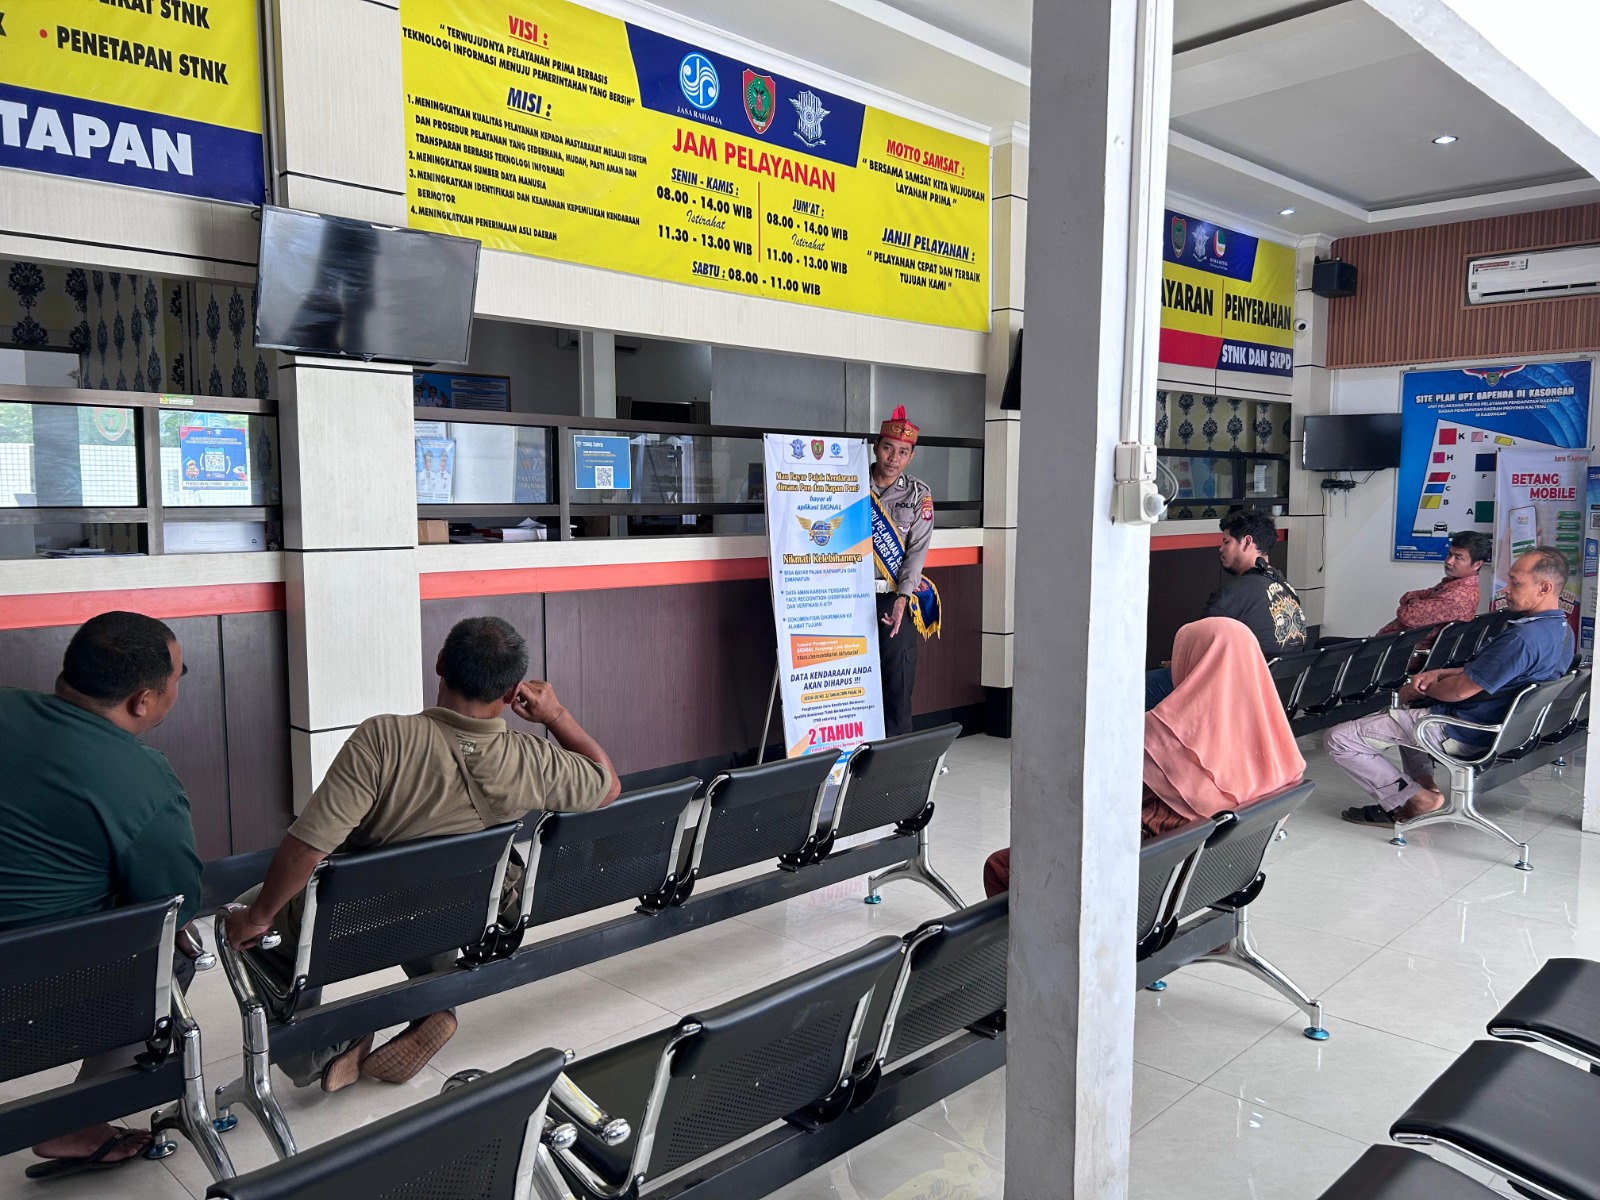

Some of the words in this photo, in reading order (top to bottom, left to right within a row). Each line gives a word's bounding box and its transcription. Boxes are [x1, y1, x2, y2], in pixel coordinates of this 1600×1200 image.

[160, 0, 210, 29] STNK
[509, 15, 538, 42] VISI
[57, 25, 172, 73] PENETAPAN
[179, 53, 228, 85] STNK
[402, 27, 451, 51] TEKNOLOGI
[453, 43, 497, 66] INFORMASI
[499, 58, 530, 76] MENUJU
[533, 68, 587, 93] PEMERINTAHAN
[589, 84, 607, 99] YANG
[447, 26, 504, 53] TERWUJUDNYA
[507, 45, 550, 67] PELAYANAN
[552, 59, 575, 75] PRIMA
[577, 67, 608, 85] BERBASIS
[507, 87, 542, 114] MISI
[677, 106, 693, 117] JASA
[693, 111, 722, 125] RAHARJA
[0, 101, 193, 176] TAPAN
[415, 96, 470, 119] MENINGKATKAN
[472, 111, 502, 128] KUALITAS
[504, 120, 539, 138] PELAYANAN
[540, 130, 564, 145] KEPADA
[565, 137, 602, 154] MASYARAKAT
[603, 147, 627, 160] MELALUI
[628, 153, 648, 165] SISTEM
[415, 114, 431, 127] DAN
[433, 118, 469, 136] PROSEDUR
[470, 127, 508, 146] PELAYANAN
[508, 138, 526, 151] YANG
[527, 144, 564, 162] SEDERHANA,
[565, 153, 588, 168] MUDAH,
[590, 160, 605, 170] PASTI
[606, 163, 624, 176] AMAN
[625, 168, 637, 179] DAN
[416, 133, 462, 153] TRANSPARAN
[463, 144, 493, 160] BERBASIS
[495, 152, 530, 170] TEKNOLOGI
[532, 161, 565, 178] INFORMASI
[672, 128, 717, 161] JAM
[724, 141, 835, 193] PELAYANAN
[886, 139, 921, 163] MOTTO
[923, 151, 960, 175] SAMSAT
[416, 152, 472, 173] MENINGKATKAN
[474, 163, 499, 179] SUMBER
[501, 172, 517, 184] DAYA
[518, 175, 546, 190] MANUSIA
[671, 168, 698, 186] SENIN
[706, 177, 734, 195] KAMIS
[869, 160, 904, 179] BERSAMA
[905, 170, 931, 187] SAMSAT
[933, 178, 948, 192] KITA
[950, 183, 985, 202] WUJUDKAN
[417, 170, 473, 190] MENINGKATKAN
[475, 182, 515, 199] IDENTIFIKASI
[517, 192, 530, 203] DAN
[532, 194, 565, 211] KEAMANAN
[567, 203, 605, 219] KEPEMILIKAN
[606, 211, 640, 226] KENDARAAN
[418, 188, 456, 204] BERMOTOR
[656, 186, 688, 204] 08.00
[701, 196, 730, 214] 14.00
[733, 204, 753, 219] WIB
[896, 182, 928, 201] LAYANAN
[930, 193, 951, 207] PRIMA
[418, 206, 474, 225] MENINGKATKAN
[476, 216, 517, 233] PENERIMAAN
[518, 225, 532, 236] ASLI
[534, 228, 557, 241] DAERAH
[686, 210, 726, 230] Istirahat
[766, 212, 794, 229] 08.00
[804, 221, 829, 237] 14.00
[831, 227, 848, 241] WIB
[658, 225, 688, 243] 11.30
[701, 234, 730, 252] 13.00
[733, 241, 753, 256] WIB
[791, 234, 825, 252] Istirahat
[882, 228, 911, 246] JANJI
[914, 235, 970, 260] PELAYANAN
[767, 248, 793, 264] 11.00
[803, 255, 829, 271] 13.00
[831, 261, 848, 275] WIB
[874, 252, 916, 270] PELAYANAN
[917, 261, 937, 274] CEPAT
[939, 265, 953, 278] DAN
[955, 269, 981, 283] TERBAIK
[692, 261, 720, 278] SABTU
[728, 268, 759, 285] 08.00
[771, 276, 799, 293] 11.00
[801, 282, 820, 296] WIB
[900, 273, 926, 287] TUJUAN
[928, 278, 946, 291] KAMI
[1224, 293, 1291, 331] PENYERAHAN
[1221, 344, 1248, 365] STNK
[1248, 348, 1268, 367] DAN
[1269, 352, 1292, 370] SKPD
[1415, 394, 1433, 404] SITE
[1435, 393, 1456, 402] PLAN
[1458, 392, 1474, 401] UPT
[1476, 390, 1514, 400] BAPENDA
[1517, 389, 1526, 398] DI
[1529, 386, 1575, 398] KASONGAN
[776, 482, 799, 492] dimana
[800, 483, 812, 492] Pun
[813, 484, 824, 492] dan
[825, 484, 844, 494] Kapan
[845, 484, 860, 492] Pun?
[789, 472, 807, 482] Bayar
[808, 472, 825, 483] Pajak
[826, 474, 858, 482] Kendaraan
[1511, 473, 1560, 485] BETANG
[809, 495, 826, 503] bayar
[1530, 487, 1576, 499] MOBILE
[873, 532, 891, 558] POLRES
[875, 520, 900, 558] PELAYANAN
[783, 553, 811, 565] Nikmati
[812, 552, 863, 564] Kelebihannya
[790, 672, 809, 682] DATA
[809, 668, 851, 681] KENDARAAN
[852, 666, 872, 675] ANDA
[803, 681, 822, 691] AKAN
[823, 677, 853, 687] DIHAPUS
[808, 728, 817, 746] 2
[819, 721, 864, 744] TAHUN
